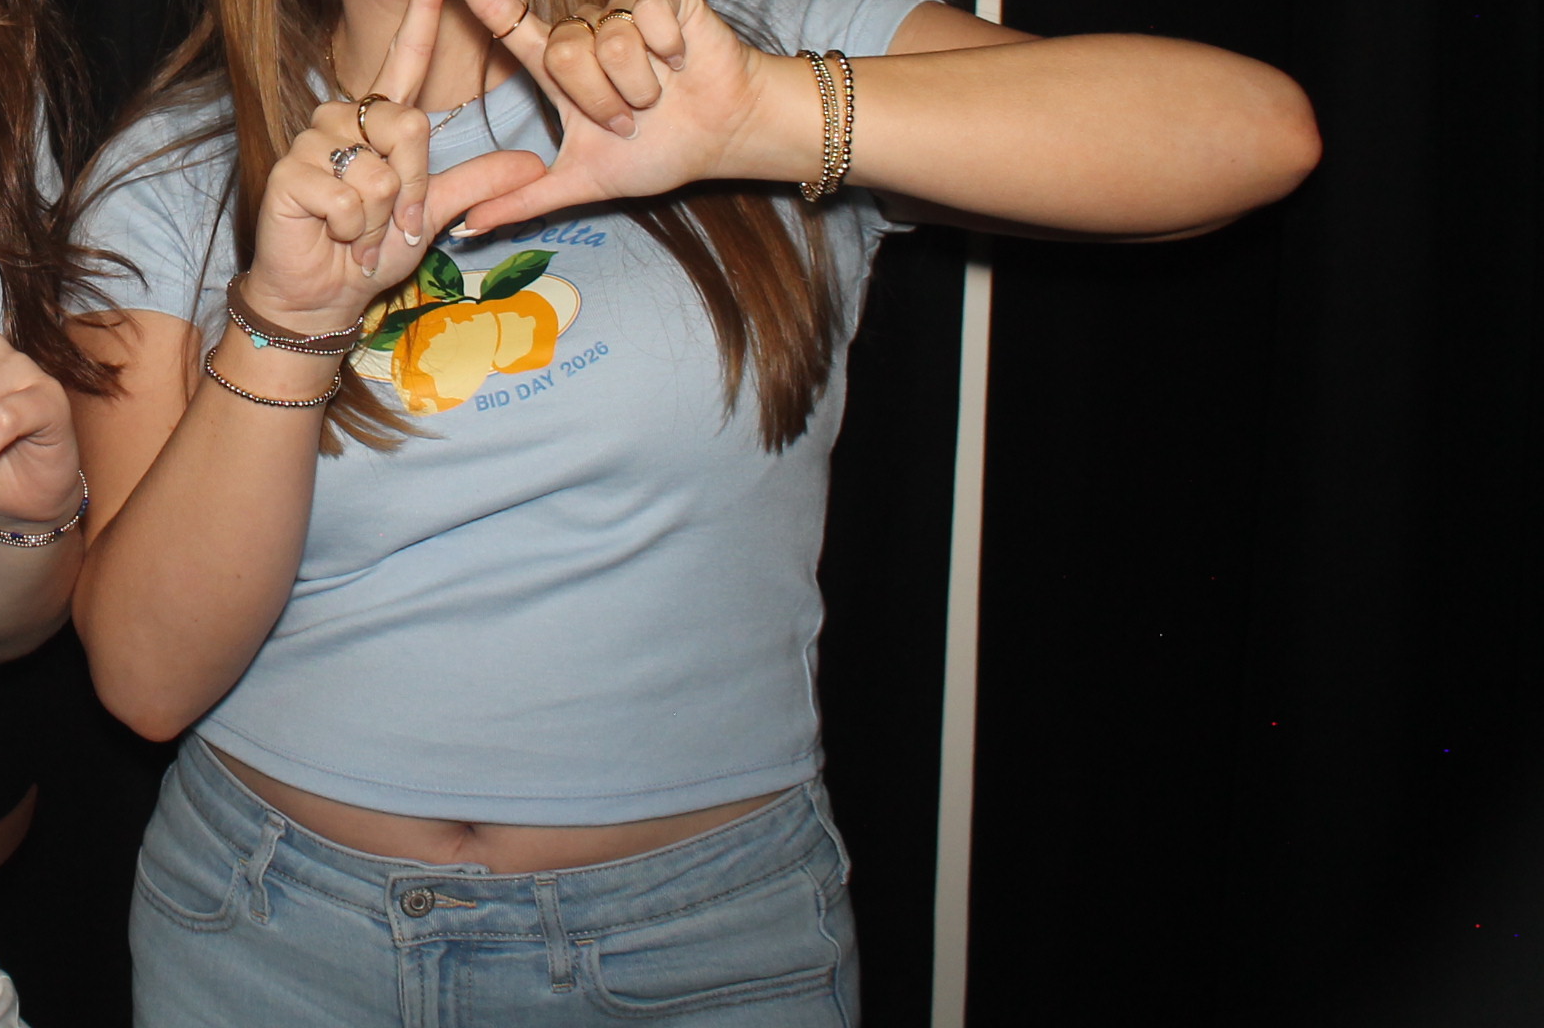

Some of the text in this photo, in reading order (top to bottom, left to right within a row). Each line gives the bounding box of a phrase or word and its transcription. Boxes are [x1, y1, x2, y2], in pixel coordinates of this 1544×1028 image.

[510, 216, 606, 247] Delta
[474, 341, 609, 412] BID DAY 2026
